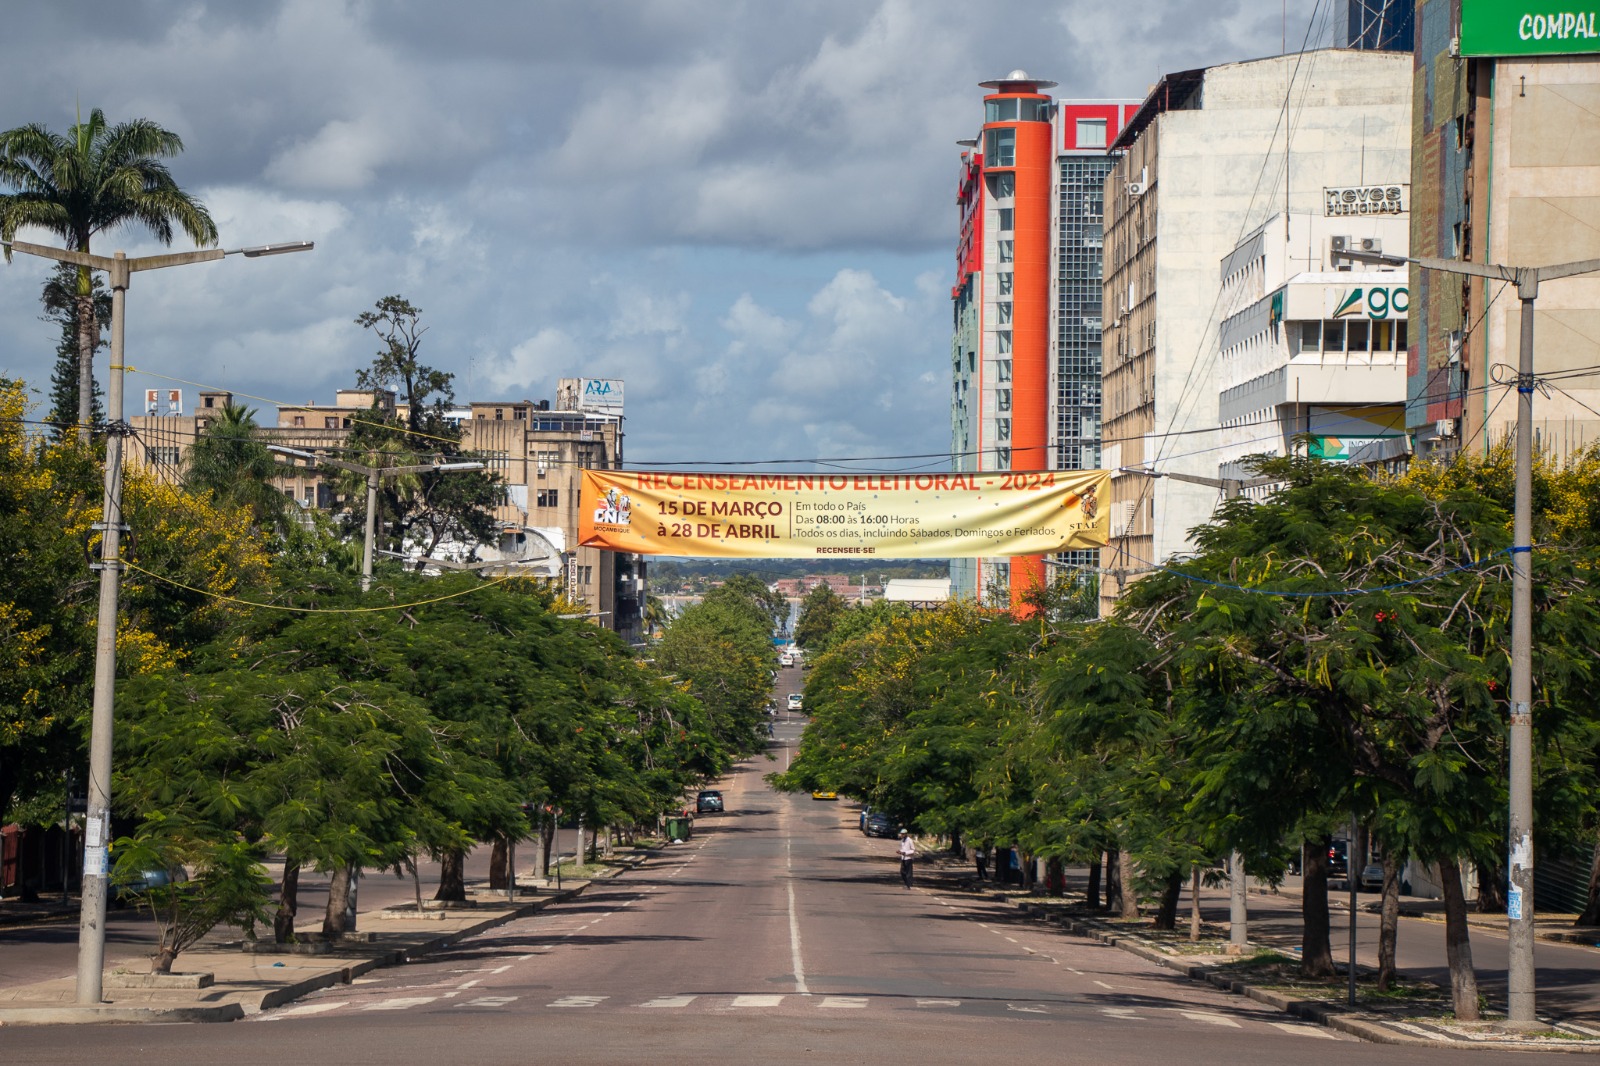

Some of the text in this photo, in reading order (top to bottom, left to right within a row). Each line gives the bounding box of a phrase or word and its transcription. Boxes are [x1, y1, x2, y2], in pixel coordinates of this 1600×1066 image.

[1519, 12, 1600, 40] COMPAL
[1326, 187, 1401, 204] neves
[1326, 201, 1402, 216] PUBLICIDADE
[637, 472, 848, 491] RECENSEAMENTO
[853, 473, 981, 491] ELEITORAL
[999, 472, 1056, 491] 2024
[658, 501, 783, 519] 15 DE MARÇO
[795, 502, 811, 511] Em
[813, 502, 836, 511] todo
[846, 501, 867, 511] País
[594, 508, 631, 525] CNE
[795, 514, 920, 524] Das 08:00 às 16:00 Horas
[657, 522, 781, 539] à 28 DE ABRIL
[795, 528, 824, 538] Todos
[826, 530, 838, 538] os
[840, 528, 862, 539] dias,
[863, 528, 908, 538] incluindo
[909, 527, 953, 539] Sábados,
[954, 527, 1004, 539] Domingos
[1014, 526, 1056, 536] Feriados
[1069, 522, 1098, 530] STAE
